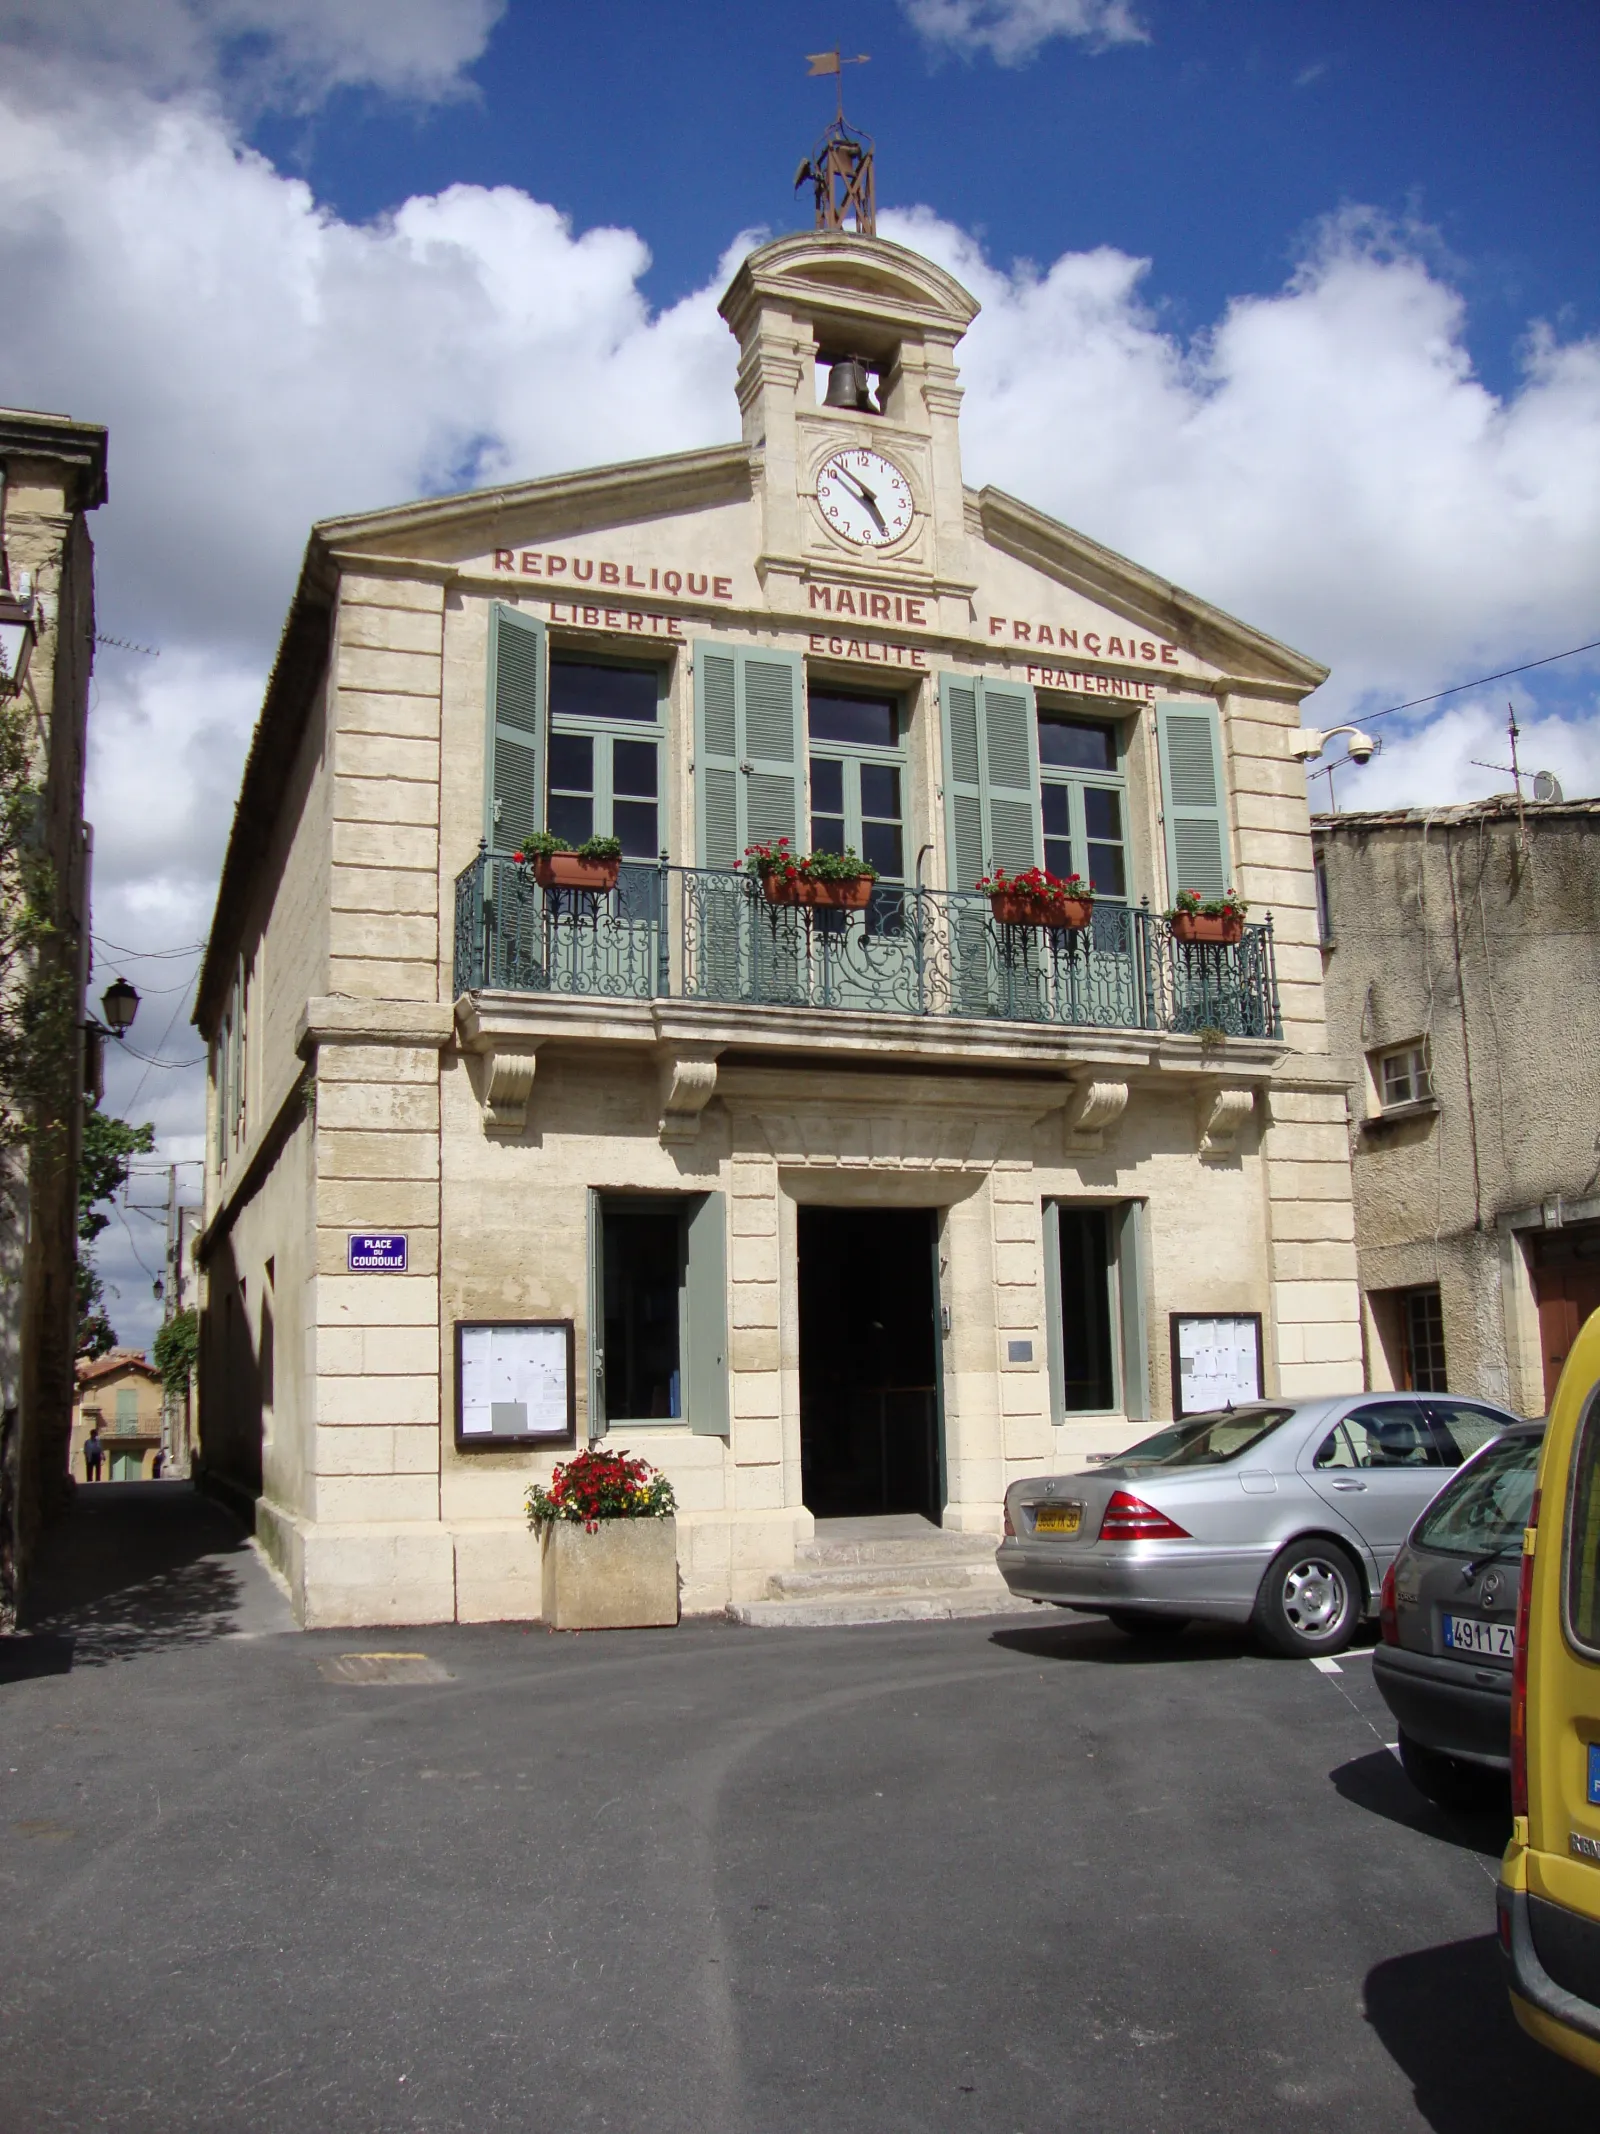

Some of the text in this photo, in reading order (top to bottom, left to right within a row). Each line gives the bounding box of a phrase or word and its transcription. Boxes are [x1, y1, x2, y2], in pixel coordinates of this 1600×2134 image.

[856, 455, 870, 467] 12
[891, 478, 901, 489] 2
[821, 486, 831, 497] 9
[898, 498, 907, 509] 3
[829, 506, 839, 517] 8
[842, 521, 851, 532] 7
[893, 516, 903, 526] 4
[862, 529, 872, 540] 6
[493, 548, 1180, 667] REPUBLIQUE FRANÇAISE
[808, 584, 928, 627] MAIRIE
[549, 602, 682, 638] LIBERTE
[808, 633, 926, 669] EGALITE
[1026, 665, 1156, 700] FRATERNITE
[364, 1240, 392, 1249] PLACE
[352, 1255, 404, 1267] COUDOULIÉ
[1454, 1621, 1493, 1652] 4911
